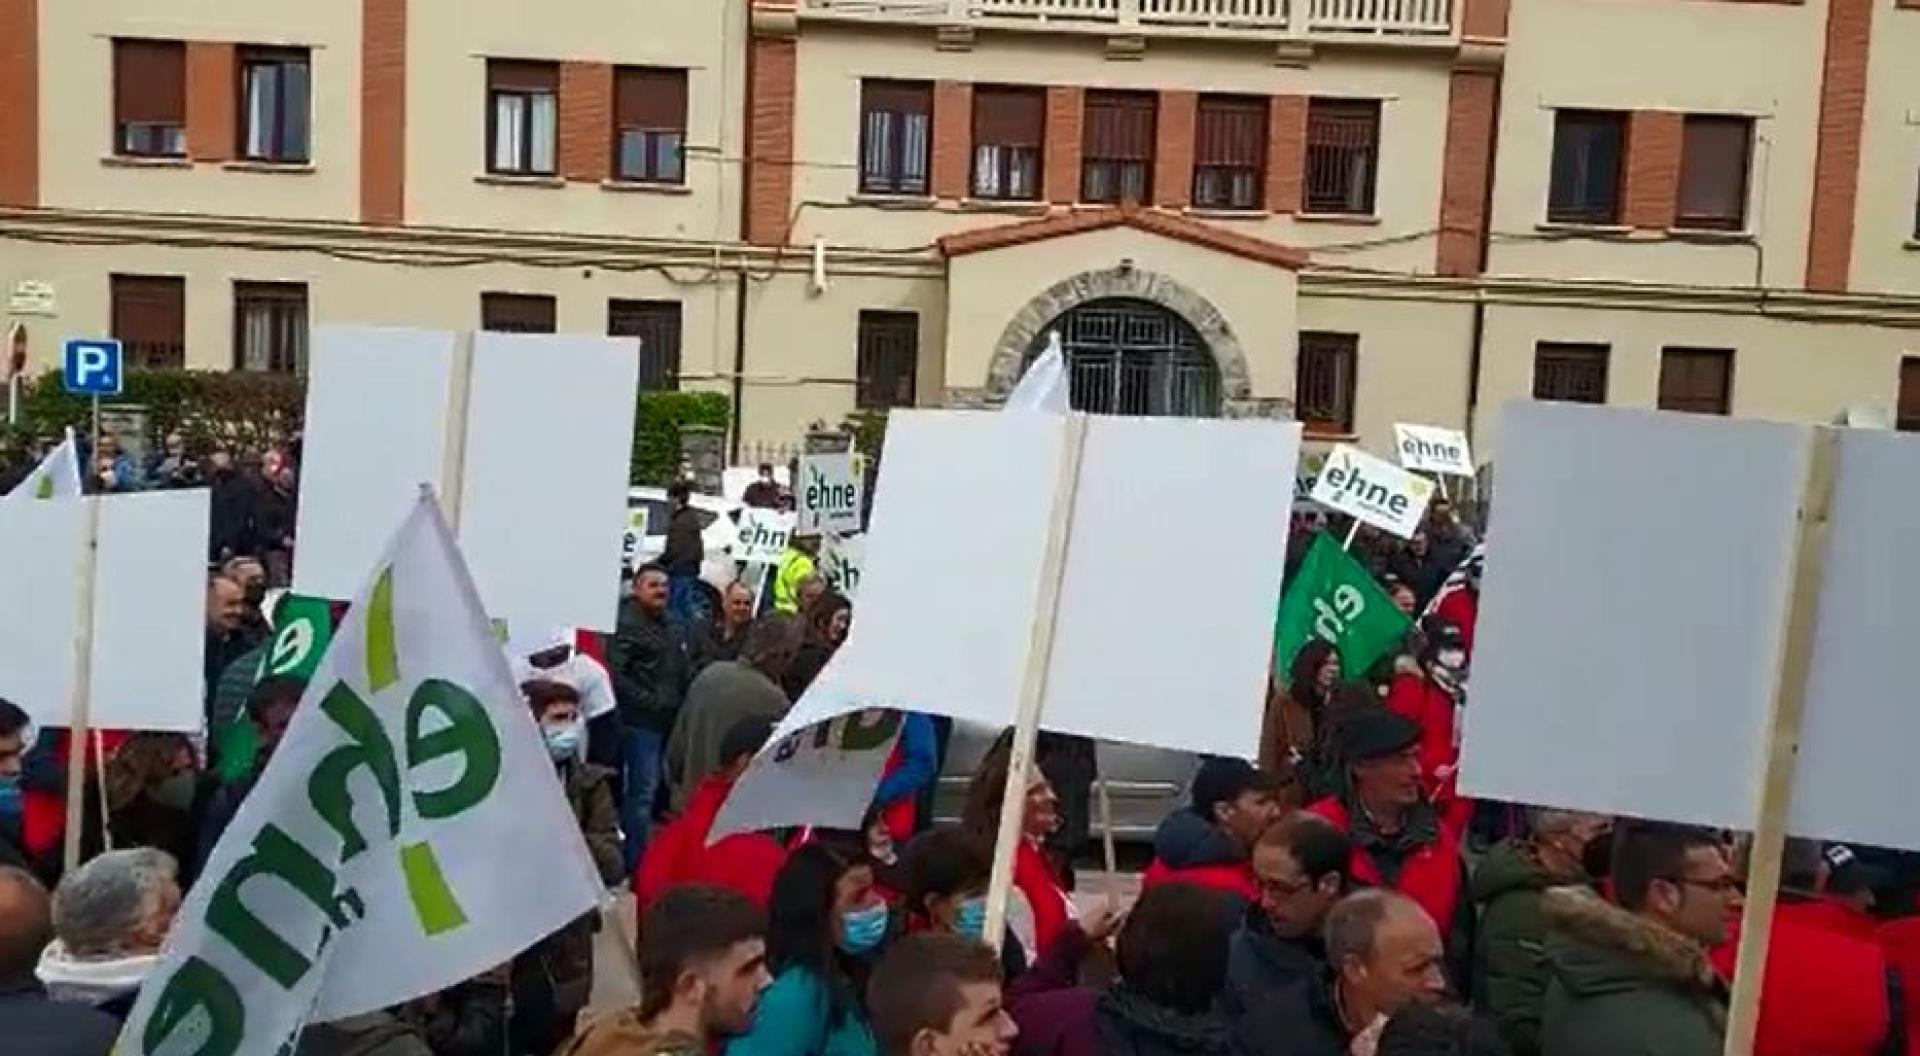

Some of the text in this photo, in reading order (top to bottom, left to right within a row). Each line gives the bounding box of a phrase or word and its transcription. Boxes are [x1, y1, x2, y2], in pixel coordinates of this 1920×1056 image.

[76, 347, 108, 386] P
[806, 474, 855, 510] ehne
[1327, 466, 1409, 514] ehne
[738, 524, 786, 545] ehn
[826, 558, 860, 592] eh
